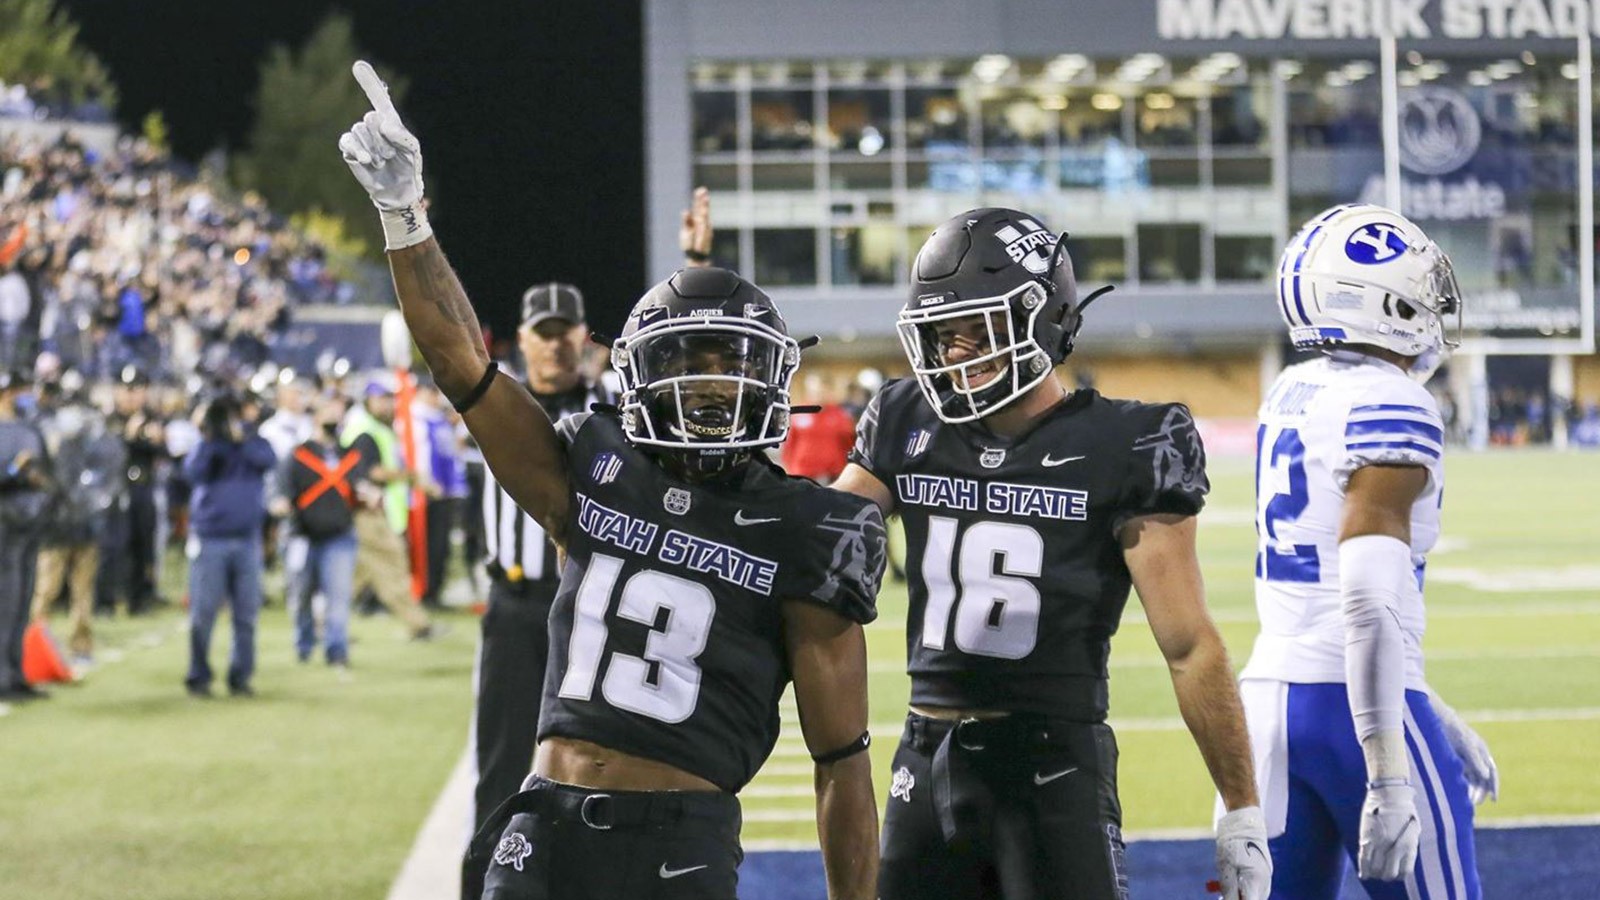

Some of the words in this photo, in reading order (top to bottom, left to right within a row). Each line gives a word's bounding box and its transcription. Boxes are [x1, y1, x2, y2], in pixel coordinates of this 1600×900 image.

[1157, 0, 1433, 39] MAVERIK
[1004, 230, 1059, 264] STATE
[1349, 225, 1409, 261] Y
[896, 475, 979, 512] UTAH
[986, 483, 1089, 521] STATE
[576, 491, 659, 556] UTAH
[658, 529, 778, 596] STATE
[921, 515, 1044, 660] 16
[558, 552, 716, 724] 13
